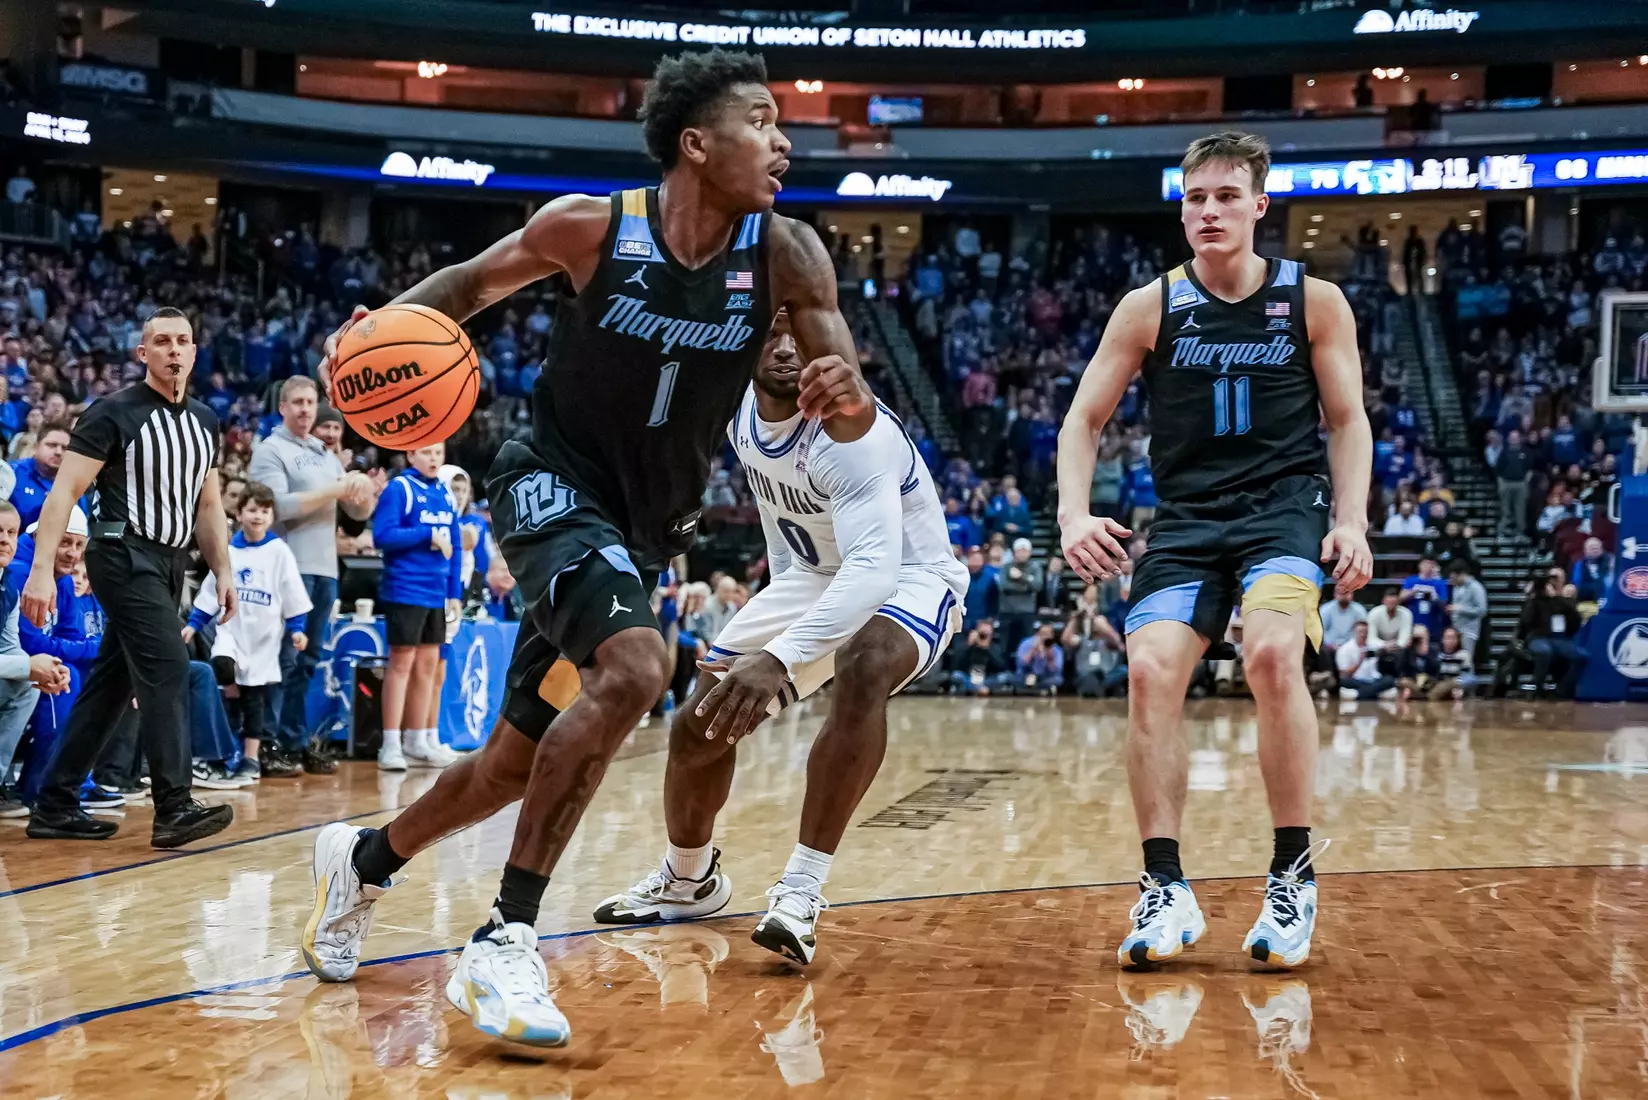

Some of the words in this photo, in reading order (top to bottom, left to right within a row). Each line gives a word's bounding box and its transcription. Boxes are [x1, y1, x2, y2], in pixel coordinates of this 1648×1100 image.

[531, 12, 571, 33] THE
[573, 16, 677, 41] EXCLUSIVE
[679, 23, 751, 45] CREDIT
[752, 26, 819, 46] UNION
[821, 27, 851, 46] OF
[853, 28, 921, 47] SETON
[923, 29, 976, 48] HALL
[977, 29, 1086, 48] ATHLETICS
[1394, 9, 1475, 33] Affinity
[416, 156, 490, 185] Affinity
[875, 175, 948, 201] Affinity
[598, 294, 753, 354] Marquette
[1171, 335, 1296, 373] Marquette
[337, 361, 423, 403] Wilson
[647, 361, 680, 427] 1
[364, 402, 430, 437] NCAA
[1213, 376, 1252, 436] 11
[777, 481, 826, 515] HALL
[777, 517, 819, 567] 0
